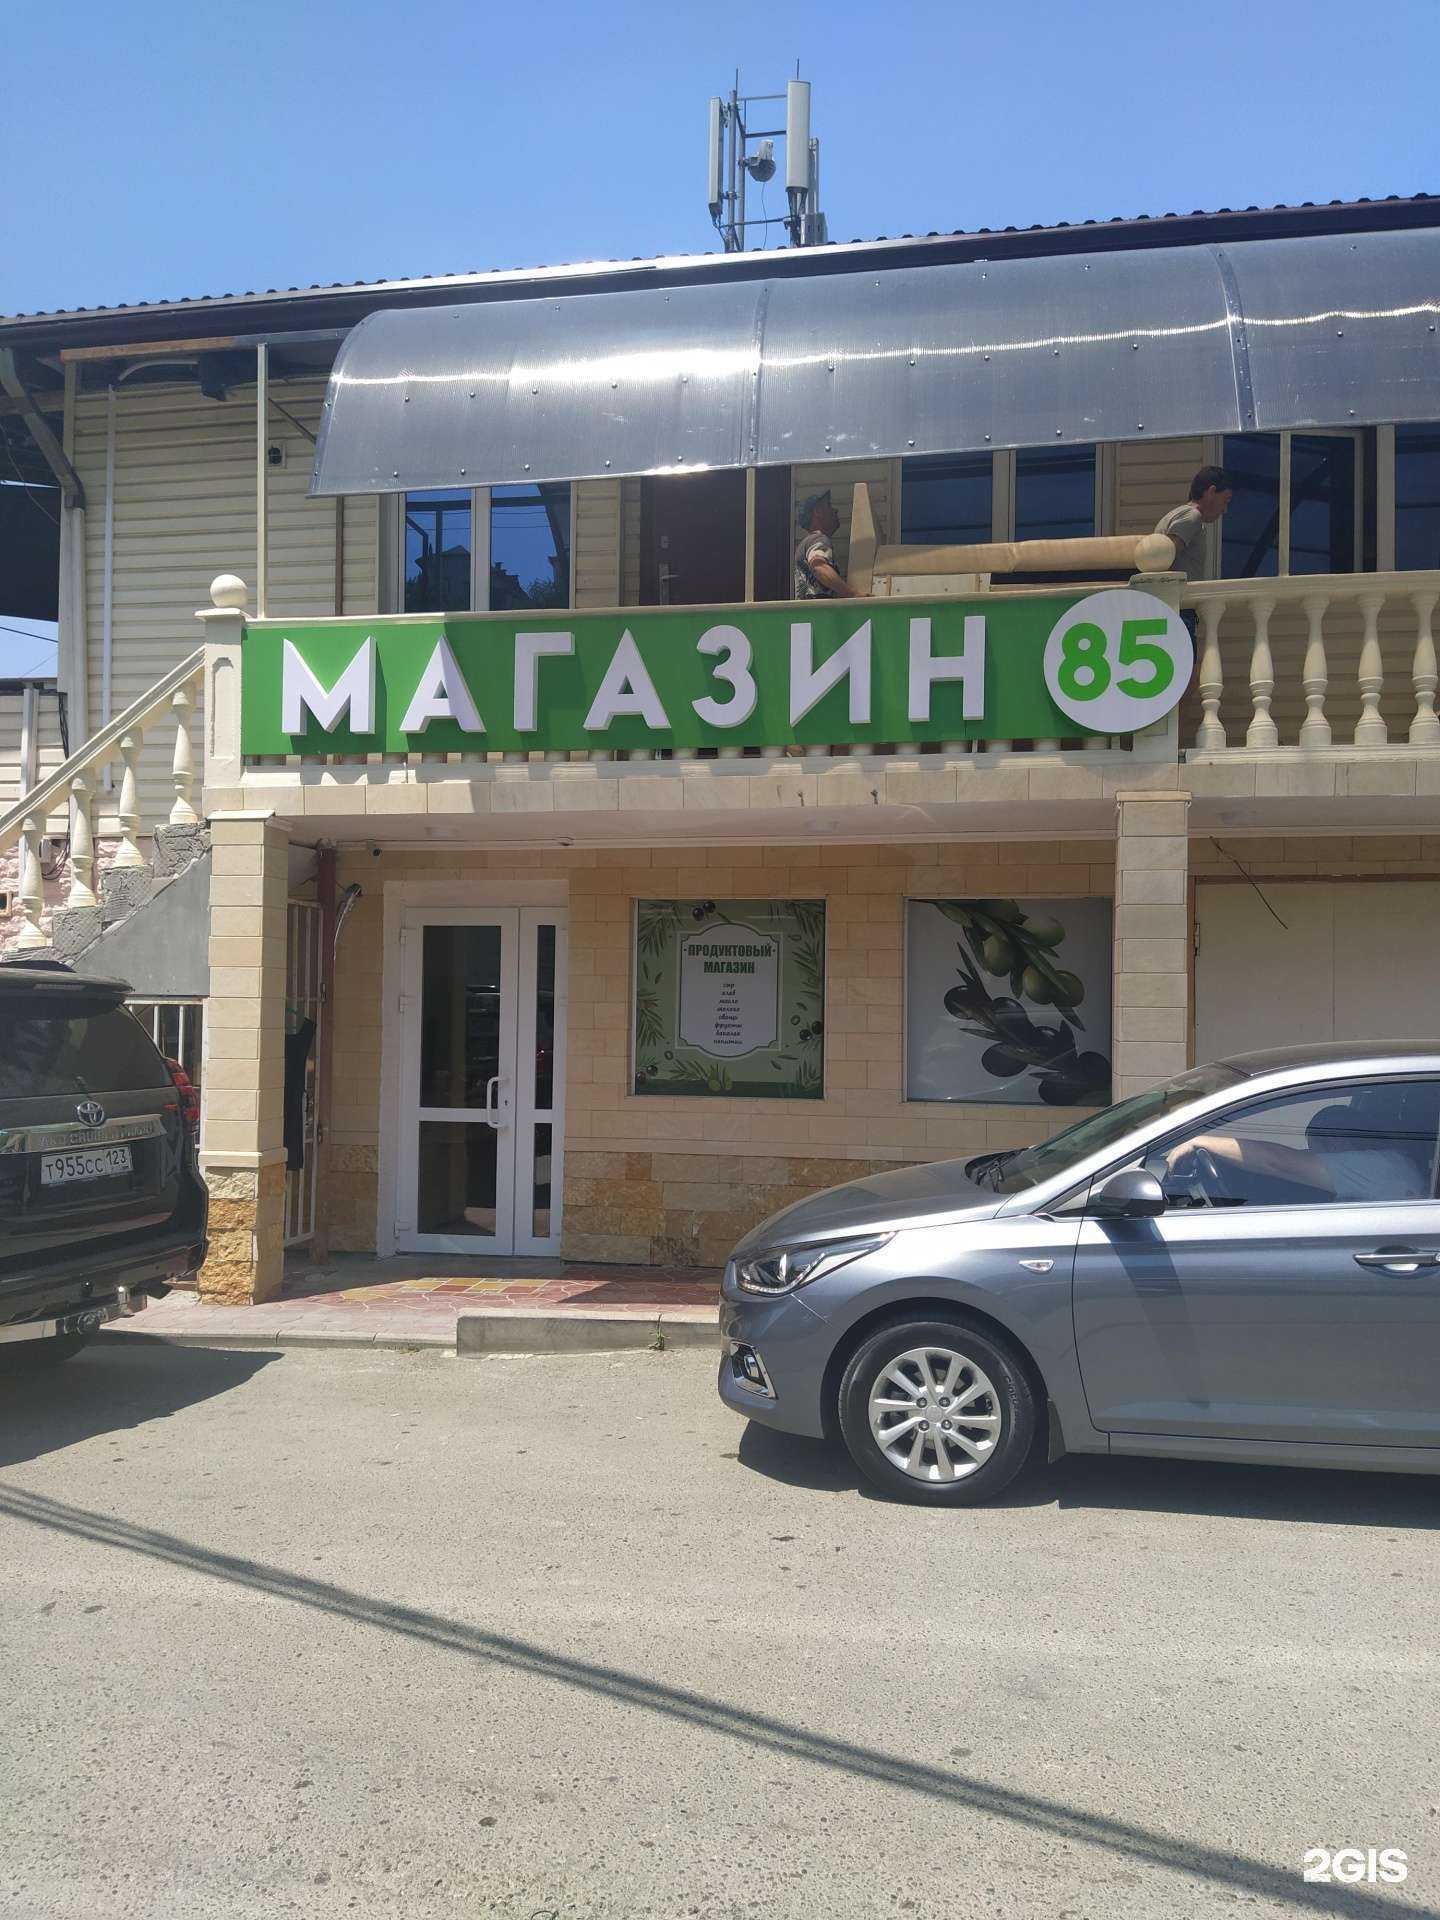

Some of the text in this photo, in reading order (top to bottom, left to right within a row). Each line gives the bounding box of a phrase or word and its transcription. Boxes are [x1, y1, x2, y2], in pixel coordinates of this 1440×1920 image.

[281, 614, 1175, 735] МАГАЗИН 85
[687, 943, 772, 958] ПРОДУКТОВЫЙ
[703, 961, 755, 974] МАГАЗИН
[106, 1149, 127, 1166] 123
